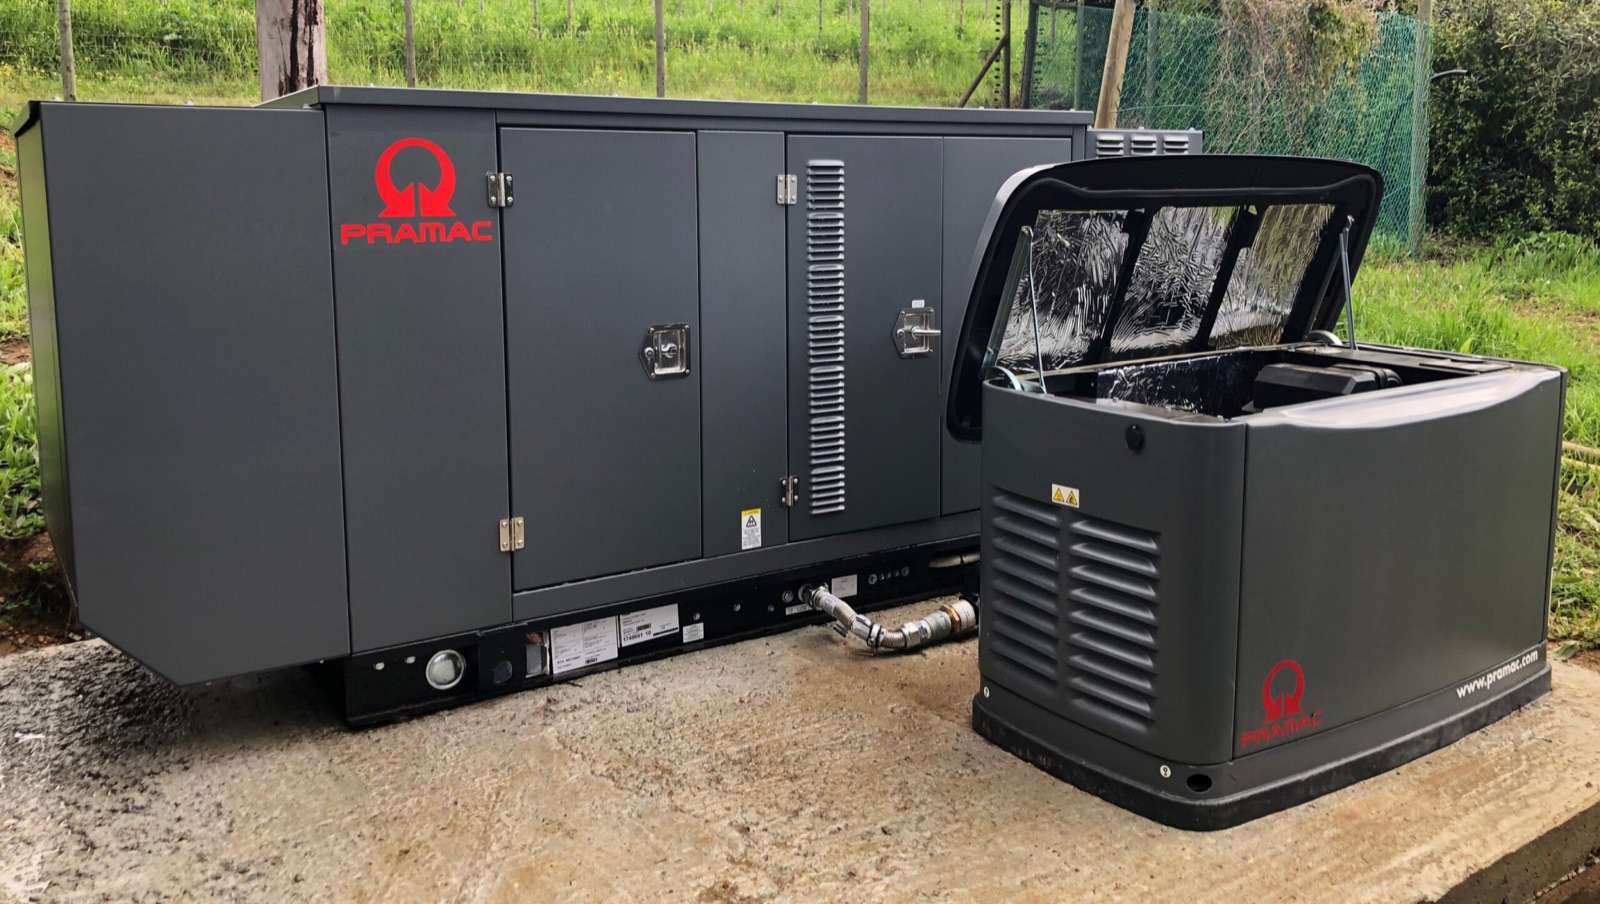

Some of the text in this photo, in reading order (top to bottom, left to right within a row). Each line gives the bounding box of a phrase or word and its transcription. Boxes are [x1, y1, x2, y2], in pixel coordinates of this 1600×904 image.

[340, 220, 493, 246] PRAMAC
[1456, 649, 1539, 699] www.pramac.com
[1239, 708, 1323, 750] PRAMAC
